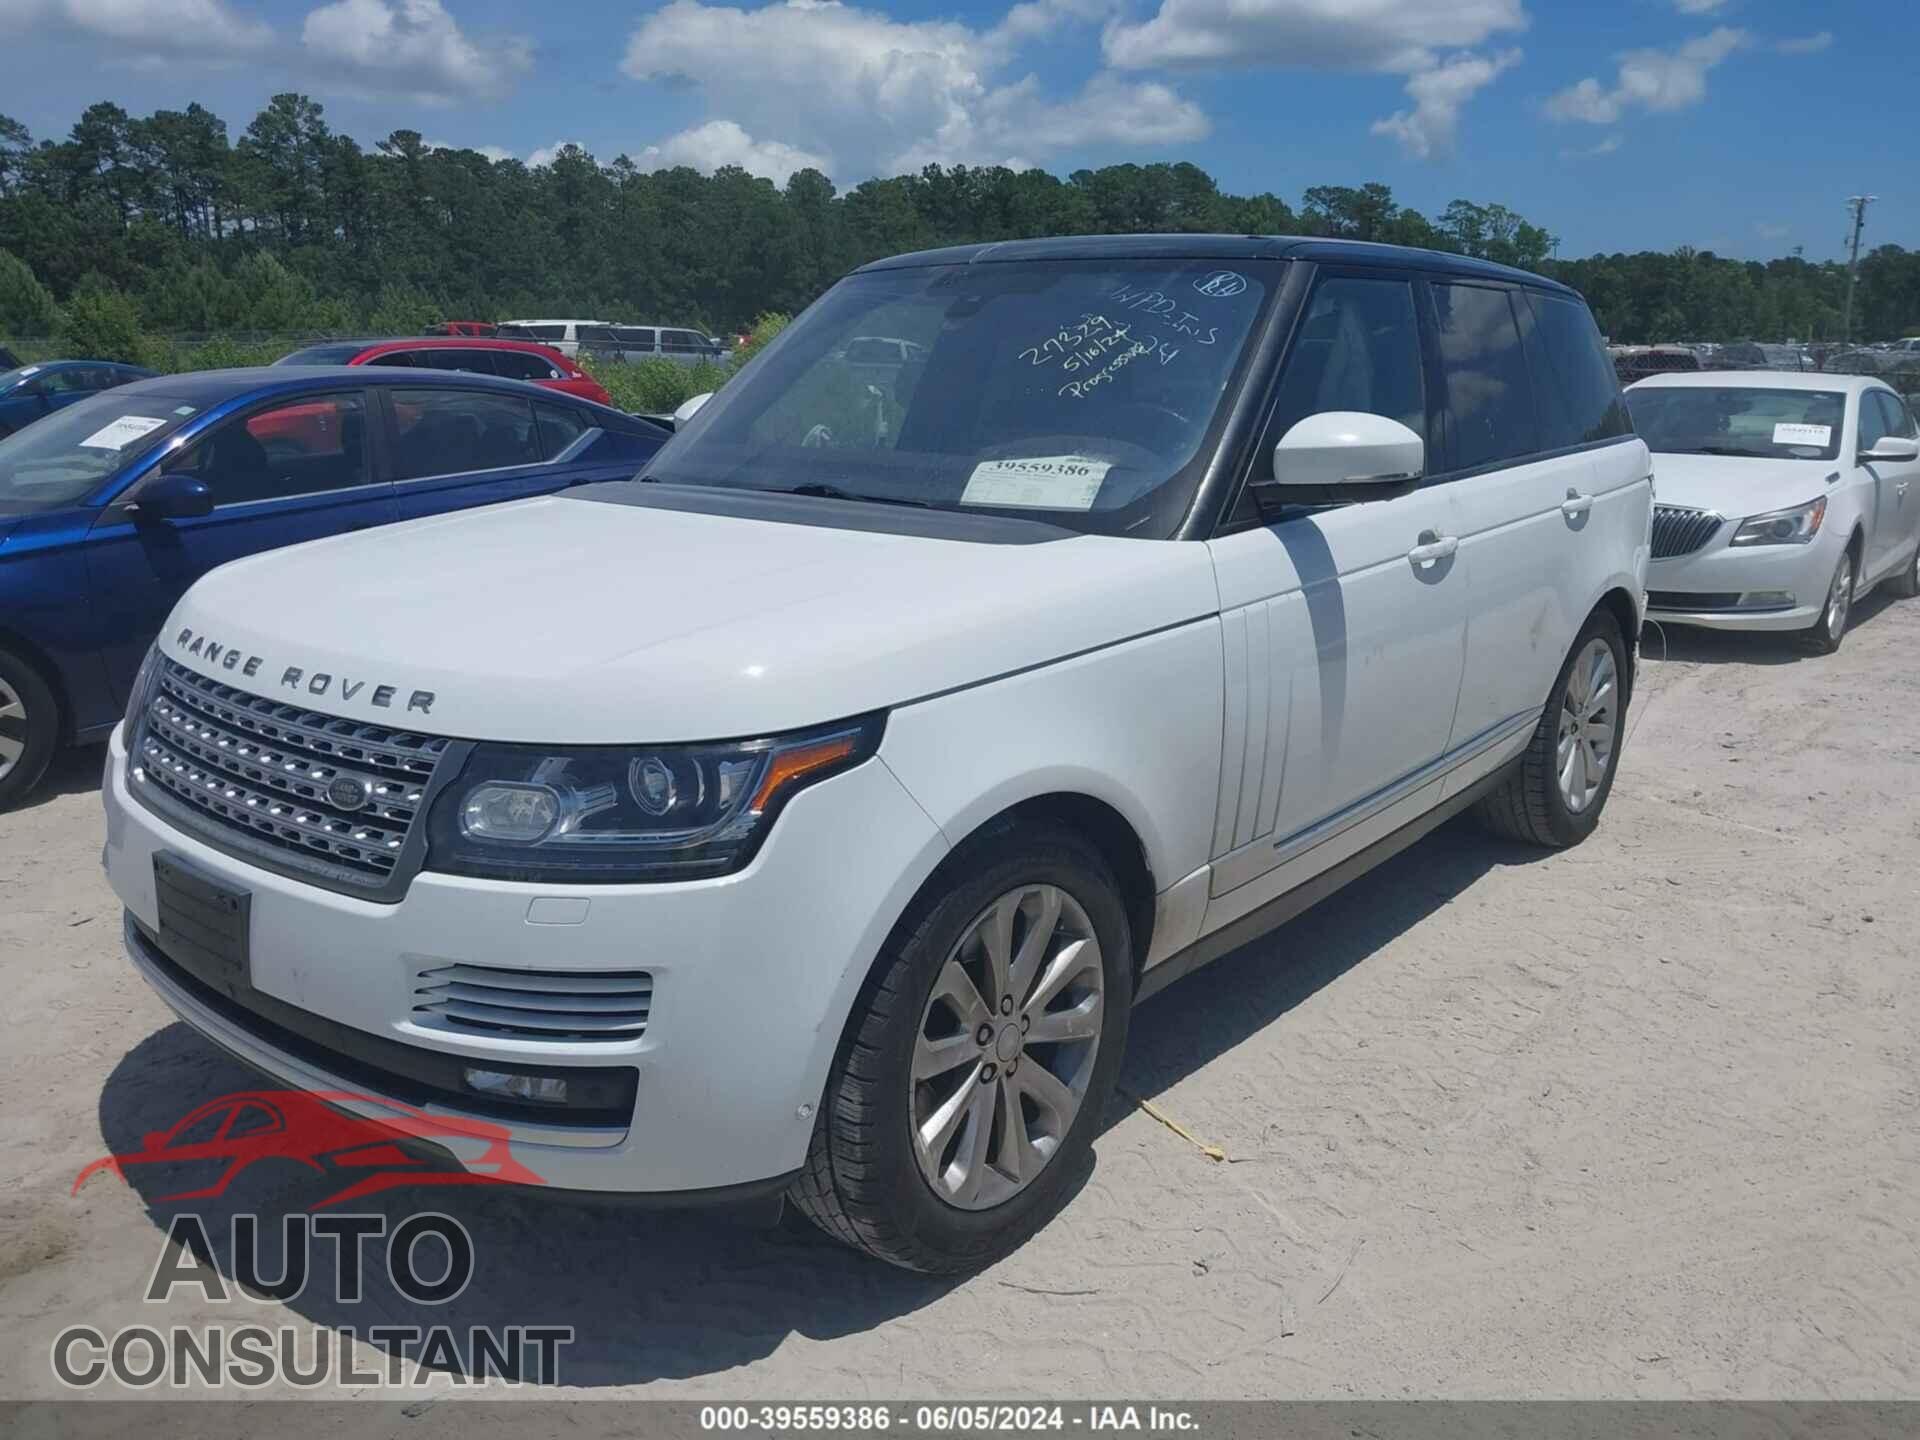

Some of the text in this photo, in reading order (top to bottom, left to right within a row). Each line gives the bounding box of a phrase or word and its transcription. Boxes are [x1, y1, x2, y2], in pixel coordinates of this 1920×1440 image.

[1018, 314, 1112, 365] 27329
[989, 461, 1089, 477] 39559386
[176, 627, 436, 714] RANGE ROVER
